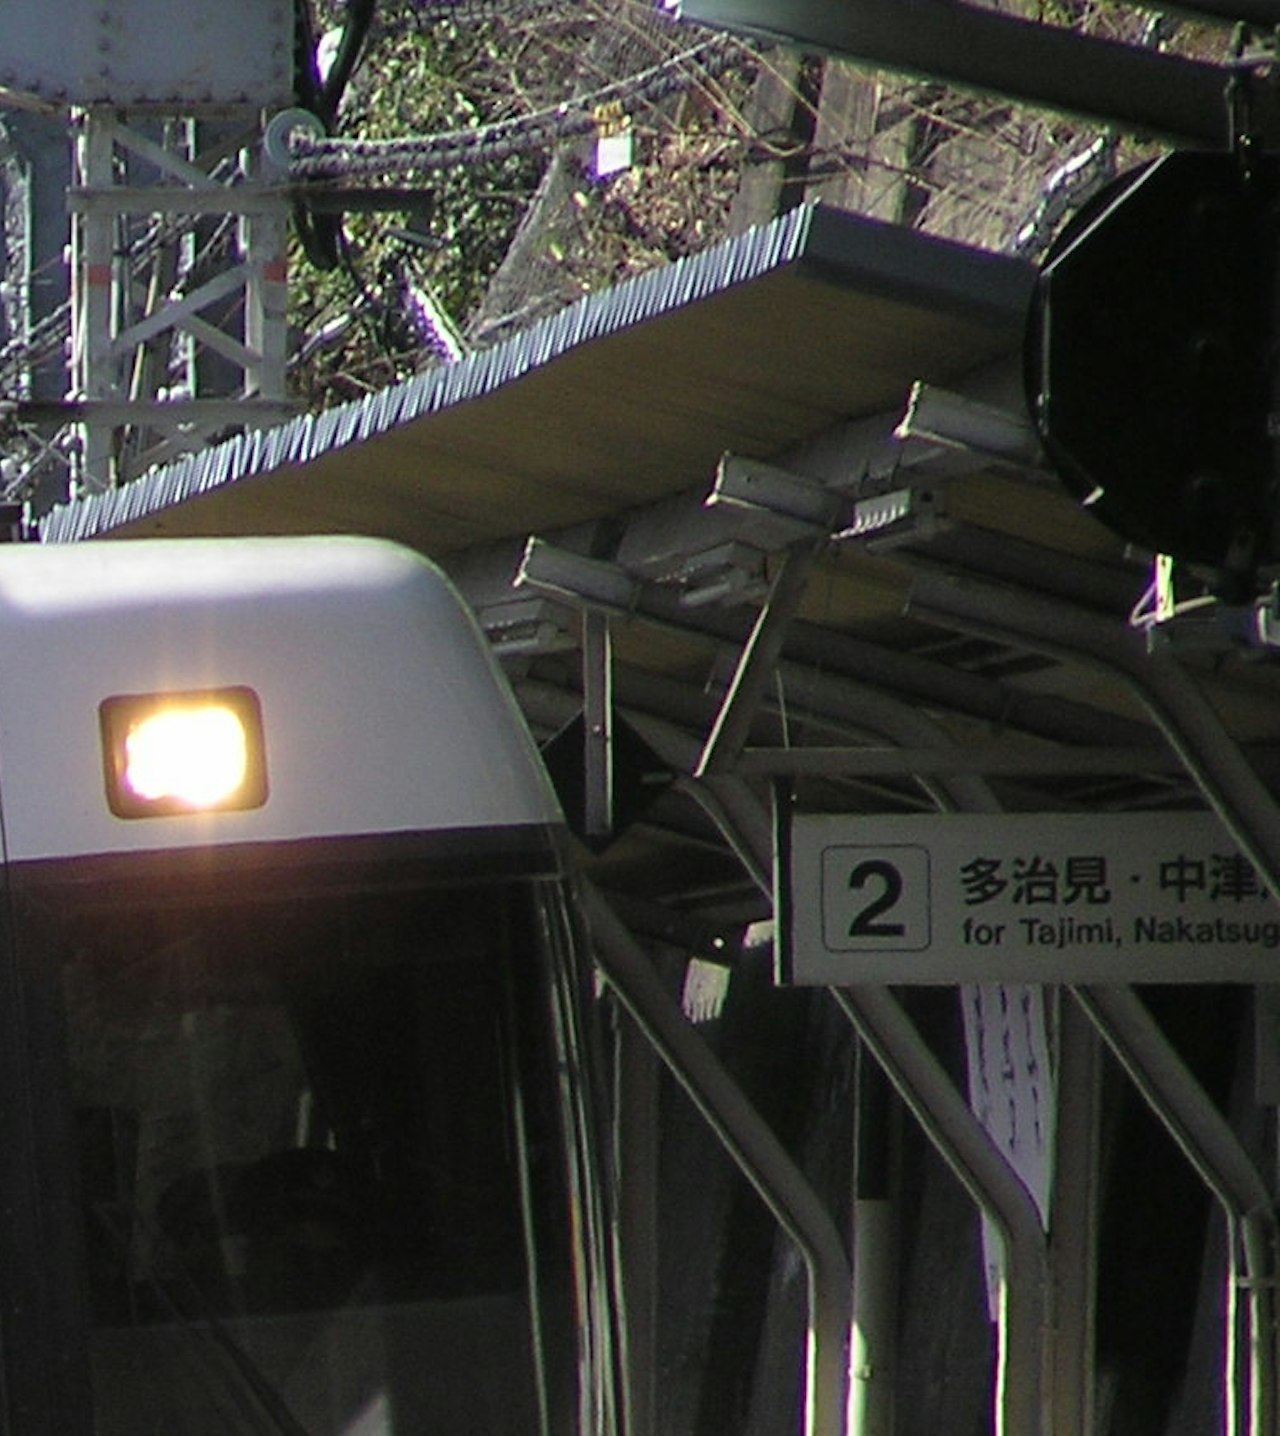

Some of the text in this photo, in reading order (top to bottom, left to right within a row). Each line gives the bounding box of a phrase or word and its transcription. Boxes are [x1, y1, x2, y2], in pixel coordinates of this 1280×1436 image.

[848, 859, 906, 938] 2
[964, 918, 1005, 944] for
[1019, 916, 1123, 951] Tajimi,
